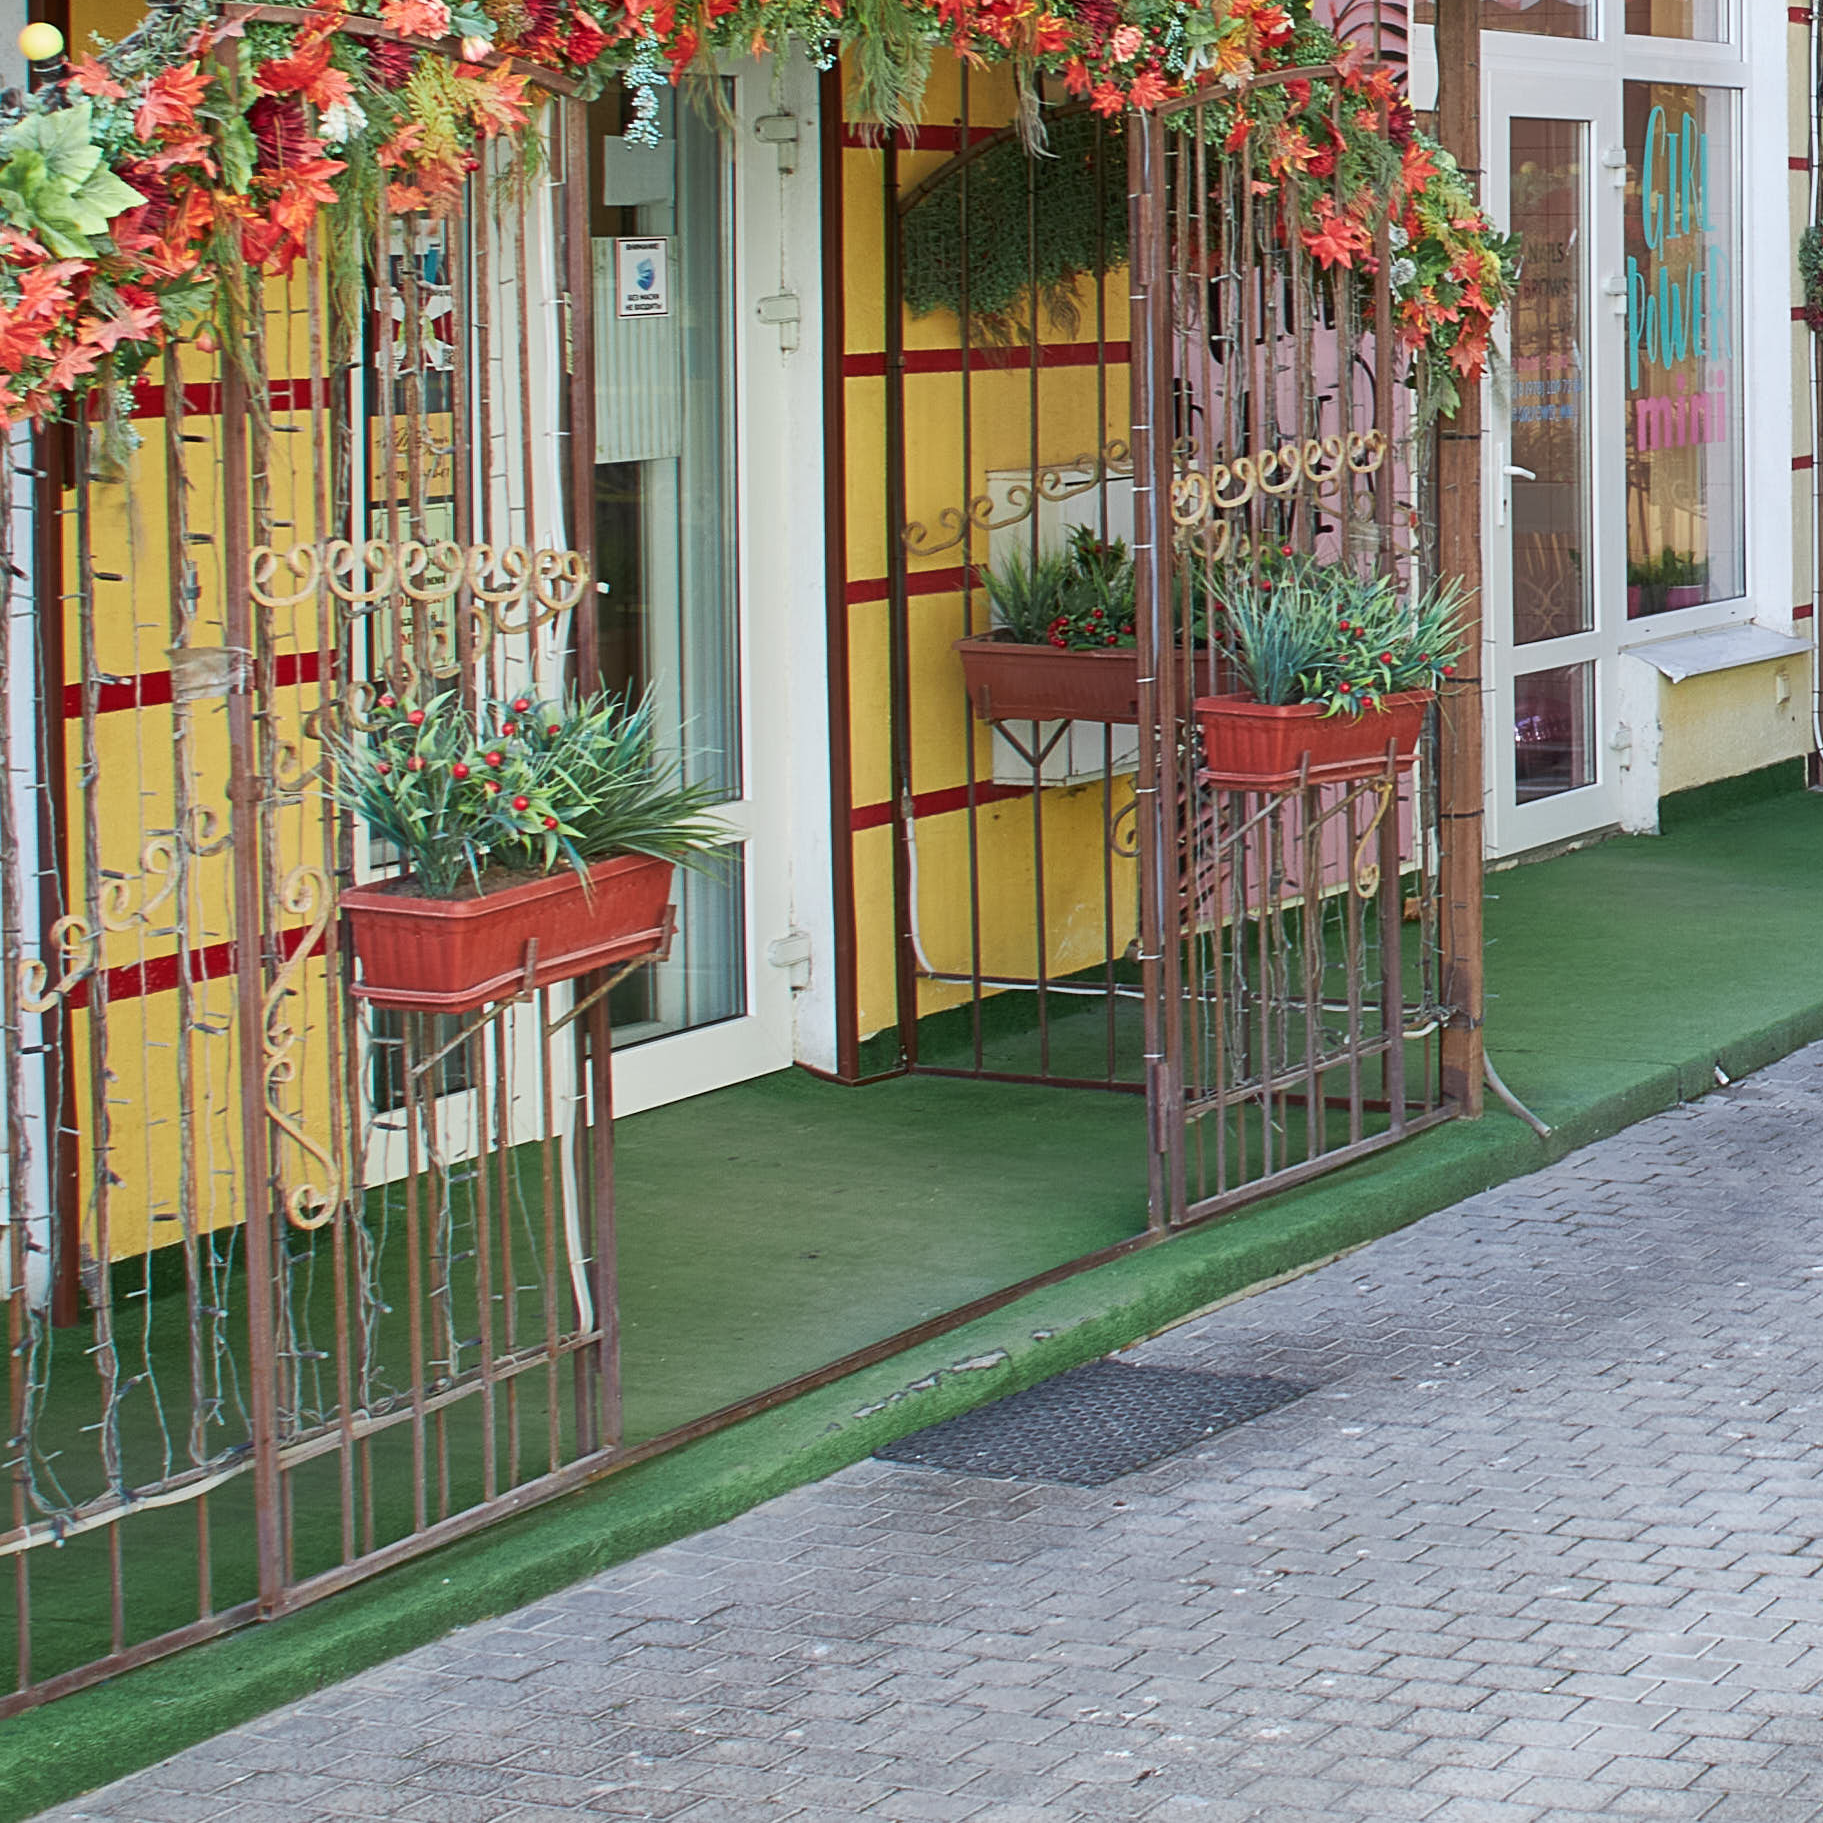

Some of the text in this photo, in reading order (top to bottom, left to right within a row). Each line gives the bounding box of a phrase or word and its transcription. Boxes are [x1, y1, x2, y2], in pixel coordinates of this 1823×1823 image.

[1642, 105, 1717, 261] GIRL
[1626, 243, 1733, 391] POWER
[1636, 368, 1726, 452] mini
